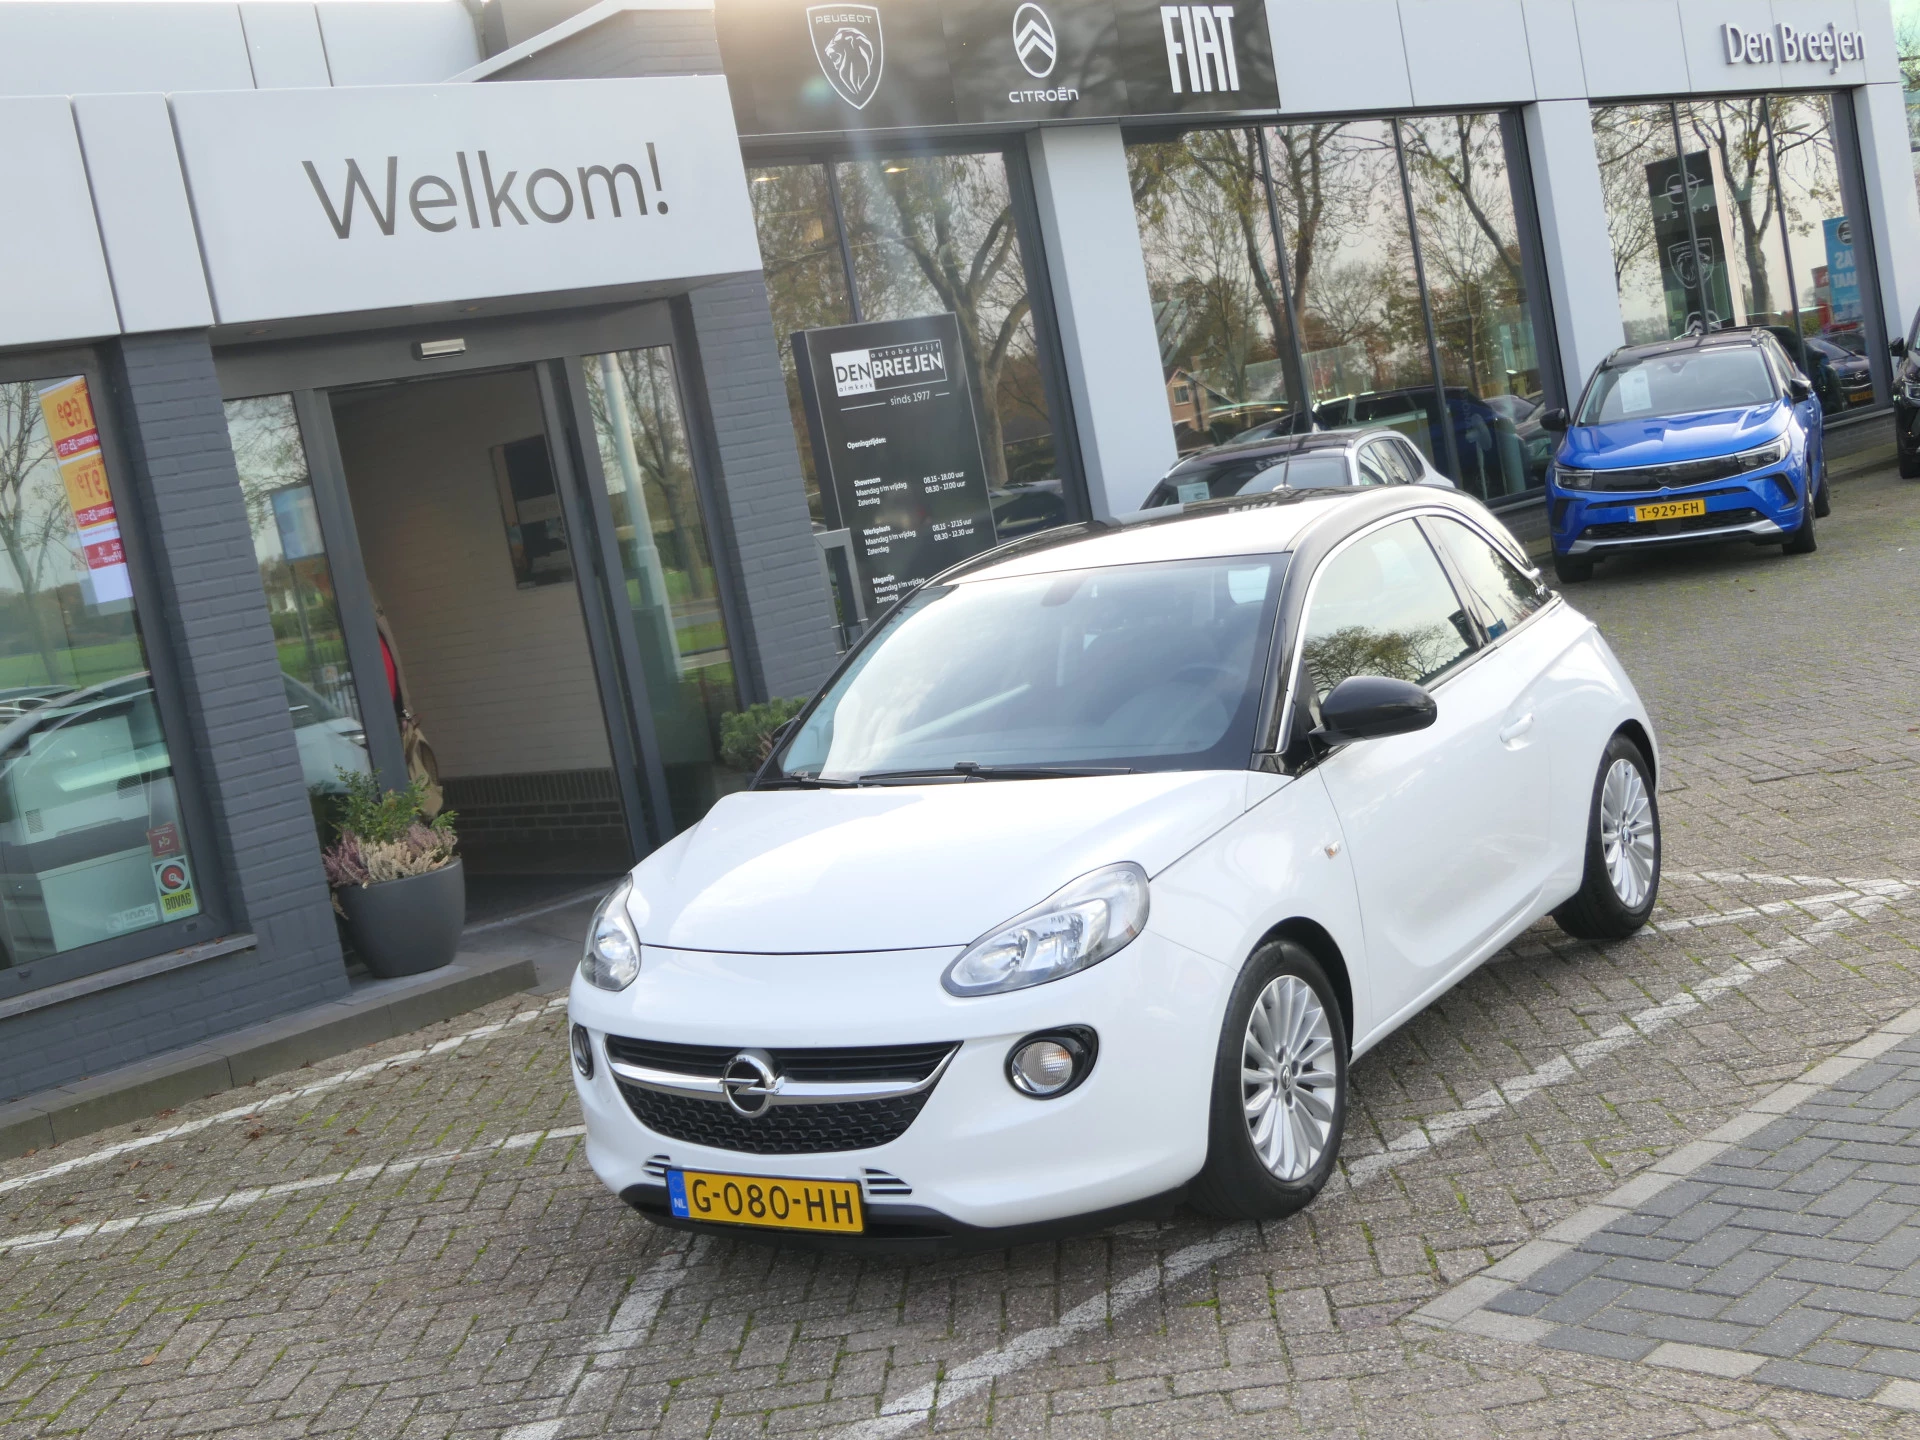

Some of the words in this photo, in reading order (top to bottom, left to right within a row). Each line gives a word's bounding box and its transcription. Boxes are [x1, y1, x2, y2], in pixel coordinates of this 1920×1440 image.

[815, 14, 873, 25] PEUGEOT
[1160, 5, 1240, 93] FIAT
[1720, 22, 1777, 65] Den
[1776, 21, 1866, 75] Breejen
[301, 142, 669, 240] Welkom!
[870, 342, 941, 359] autobedrijf
[835, 362, 872, 384] DEN
[872, 352, 943, 379] BREEJEN
[890, 394, 912, 406] sinds
[912, 390, 931, 402] 1977
[847, 437, 887, 449] Openingstijden:
[854, 477, 881, 487] Showroom
[856, 487, 880, 497] Maandag
[890, 481, 908, 492] vrijdag
[857, 497, 881, 507] Zaterdag
[956, 480, 966, 488] uur
[1640, 502, 1699, 519] T-929-FH
[863, 525, 891, 536] Werkplaats
[865, 535, 889, 546] Maandag
[898, 529, 917, 540] vrijdag
[962, 518, 972, 526] uur
[867, 546, 890, 556] Zaterdag
[872, 574, 895, 584] Magazijn
[874, 583, 898, 594] Maandag
[907, 577, 925, 587] vrijdag
[876, 594, 899, 604] Zaterdag
[165, 893, 192, 911] BOVAG
[673, 1197, 687, 1210] NL
[691, 1178, 855, 1225] G-080-HH
